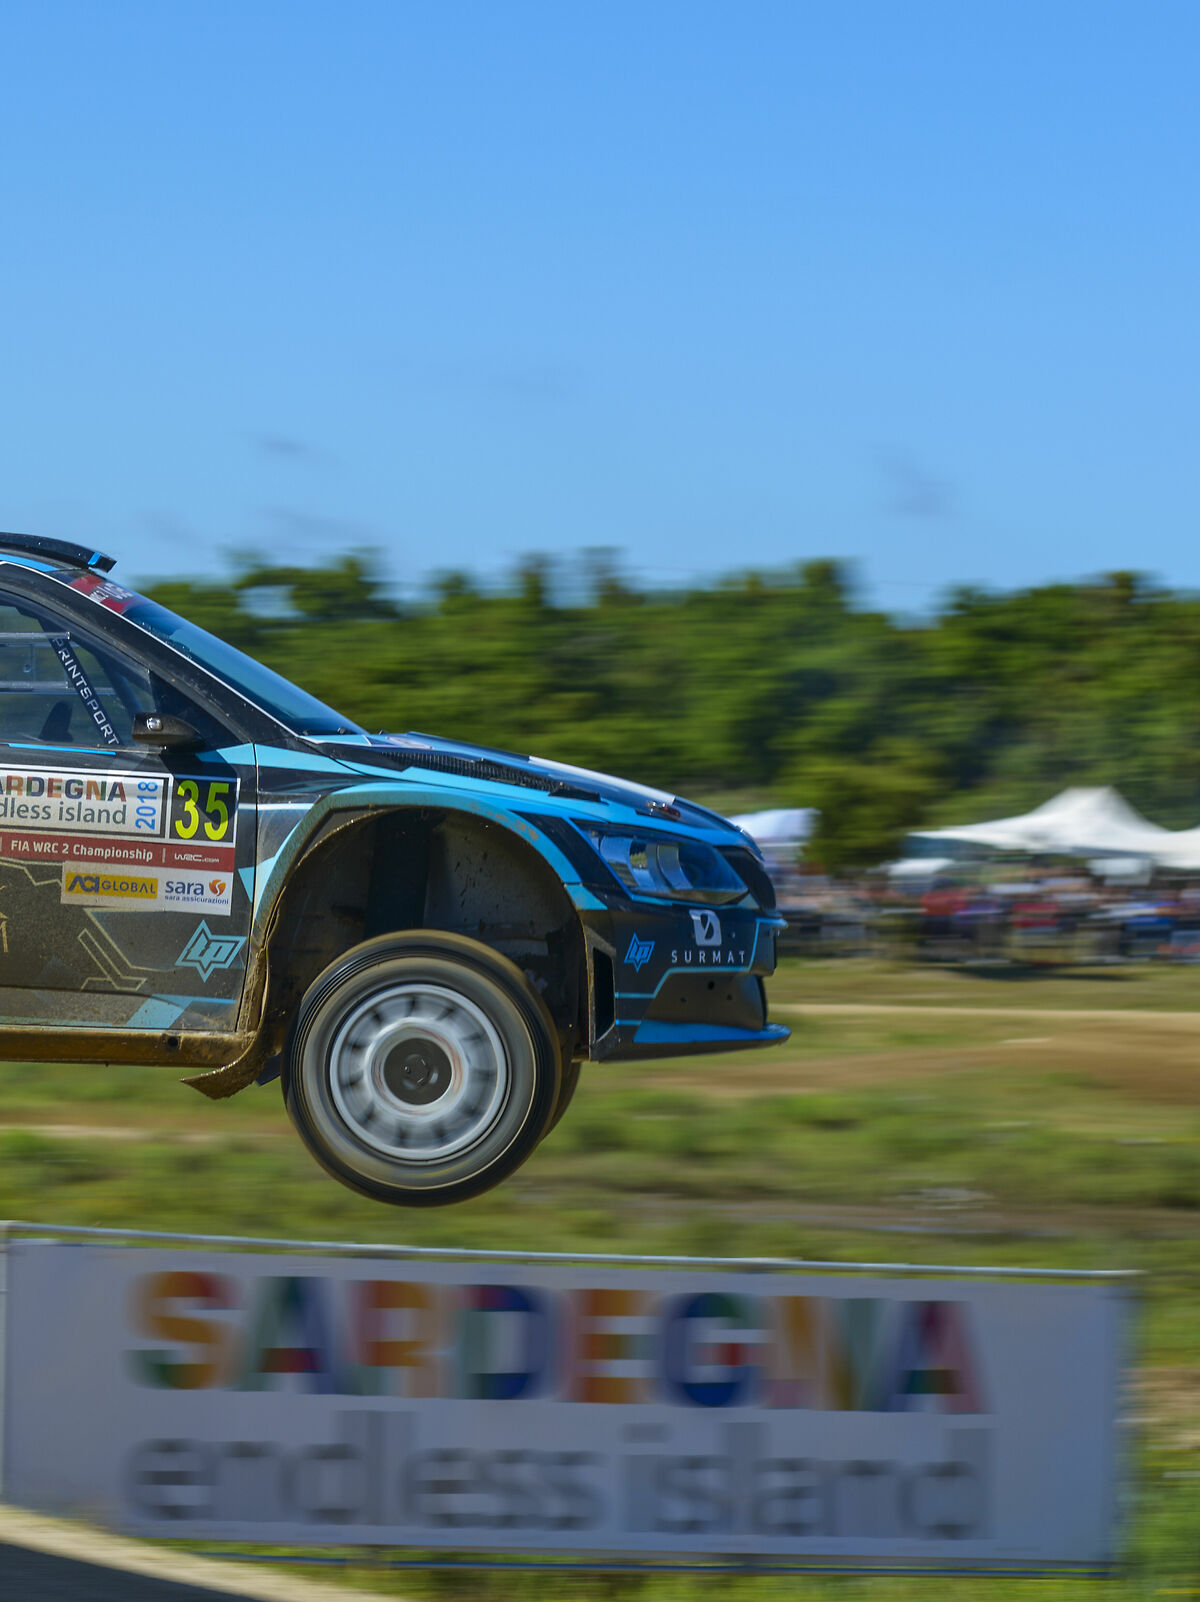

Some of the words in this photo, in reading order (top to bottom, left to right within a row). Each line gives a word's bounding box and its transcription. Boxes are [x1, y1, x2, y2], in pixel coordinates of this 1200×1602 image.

[58, 801, 127, 825] island
[135, 781, 159, 830] 2018
[174, 780, 230, 841] 35
[11, 839, 30, 852] FIA
[33, 841, 58, 853] WRC
[62, 843, 69, 854] 2
[73, 844, 154, 862] Championship
[101, 880, 156, 894] GLOBAL
[165, 880, 205, 896] sara
[182, 896, 229, 905] assicurazioni
[671, 951, 746, 964] SURMAT
[126, 1270, 991, 1414] SARDEGNA
[124, 1410, 602, 1529] endless
[616, 1422, 996, 1540] island
